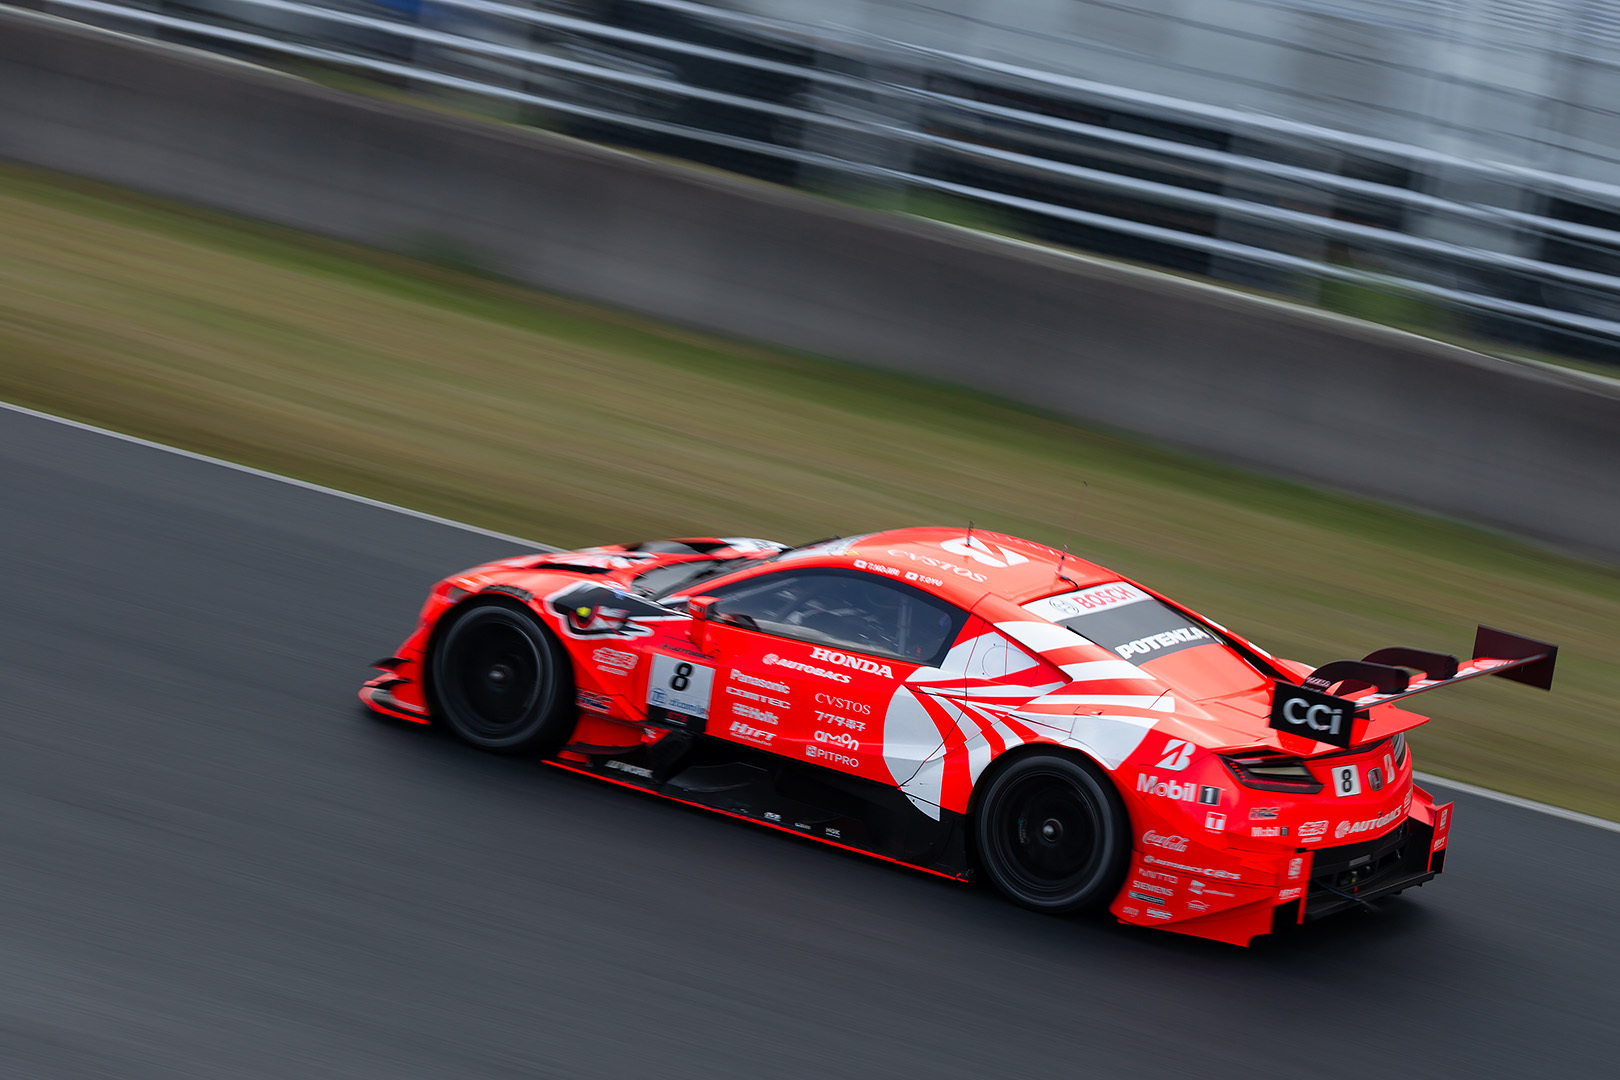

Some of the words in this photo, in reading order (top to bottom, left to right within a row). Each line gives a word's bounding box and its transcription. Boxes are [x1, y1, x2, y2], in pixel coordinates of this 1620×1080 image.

[887, 549, 987, 583] CVSTOS
[1071, 586, 1137, 609] BOSCH
[1115, 626, 1212, 660] POTENZA
[776, 657, 852, 684] AUTOBACS
[810, 647, 894, 679] HONDA
[670, 662, 694, 692] 8
[730, 668, 790, 695] Panasonic
[815, 692, 871, 715] CVSTOS
[817, 748, 859, 767] PITPRO
[1136, 773, 1197, 803] Mobil
[1341, 768, 1353, 793] 8
[1349, 805, 1402, 834] AUTOBACS
[1133, 880, 1174, 897] SIEMENS
